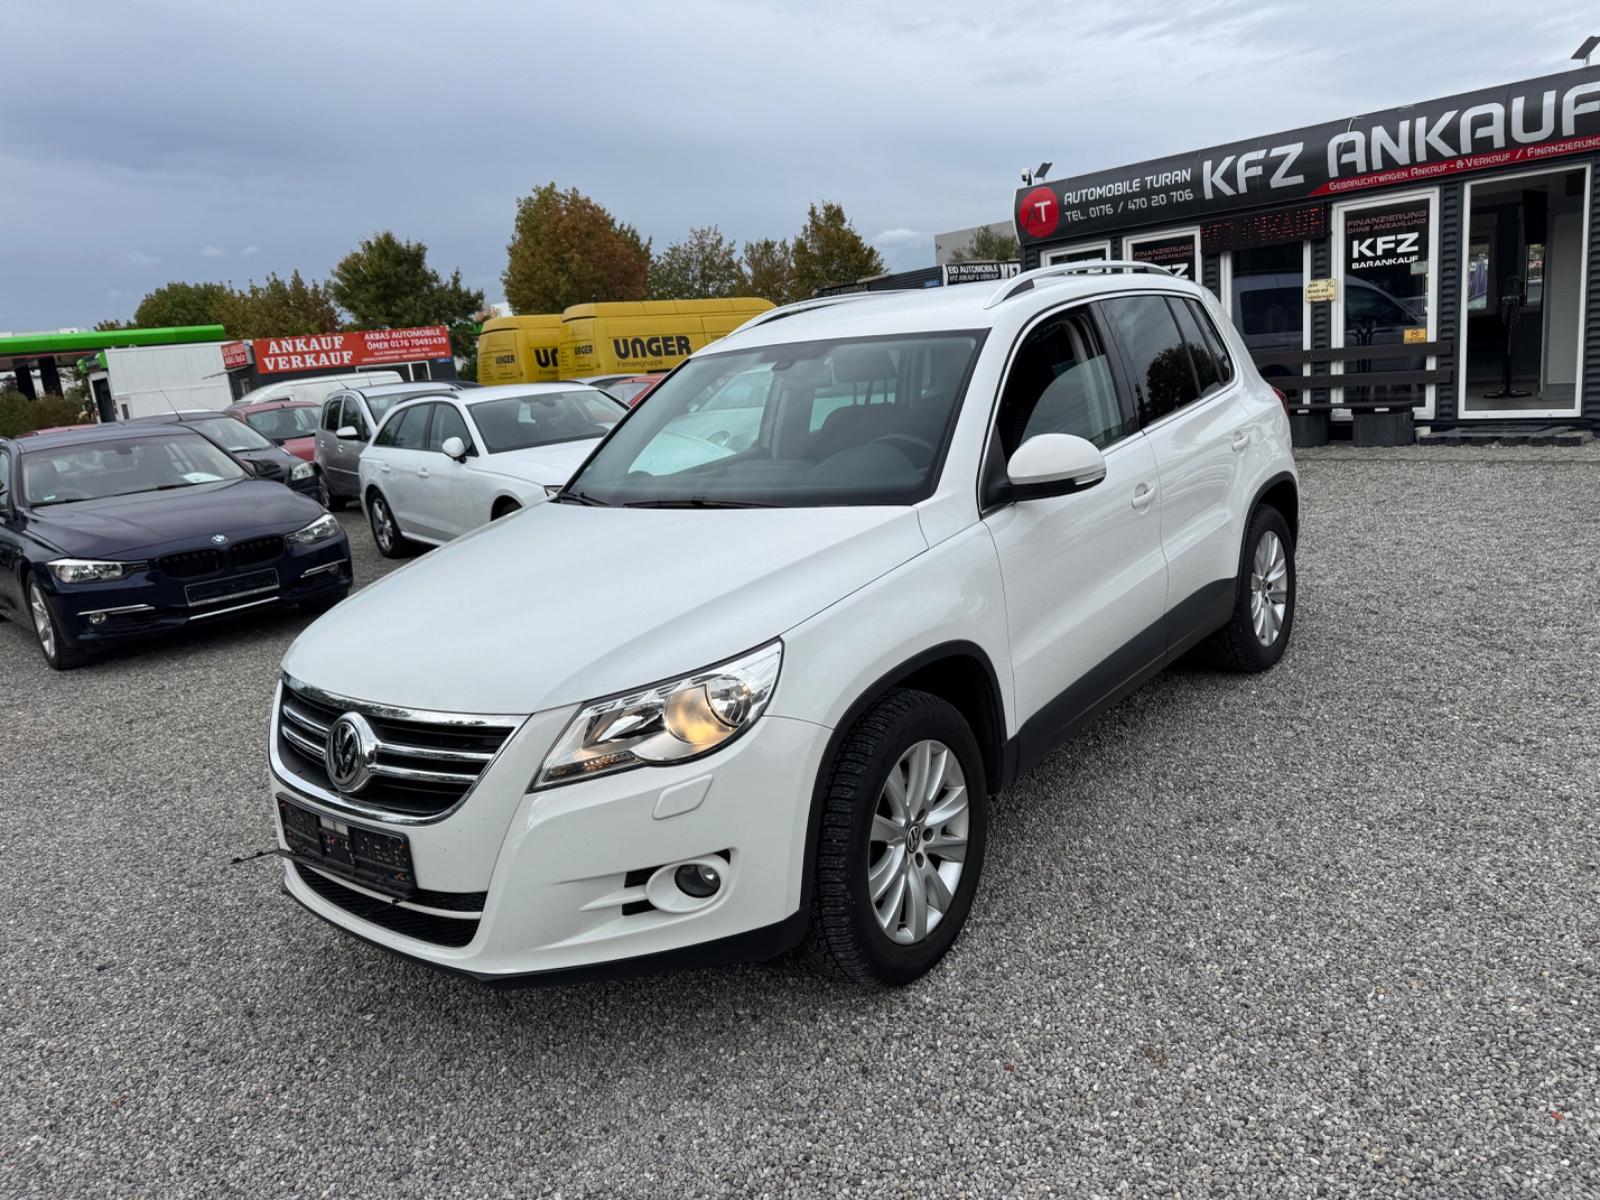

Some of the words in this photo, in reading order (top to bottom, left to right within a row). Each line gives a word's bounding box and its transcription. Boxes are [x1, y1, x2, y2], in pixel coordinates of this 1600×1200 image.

[1202, 141, 1305, 200] KFZ
[1327, 80, 1600, 178] ANKAUF
[1515, 149, 1523, 160] /
[1064, 177, 1141, 206] AUTOMOBILE
[1145, 167, 1192, 190] TURAN
[1065, 209, 1087, 223] TEL.
[1089, 204, 1114, 218] 0176
[1117, 201, 1124, 213] /
[1127, 197, 1148, 211] 470
[1151, 194, 1167, 207] 20
[1170, 188, 1194, 203] 706
[1347, 210, 1427, 228] FINANZIERUNG
[1347, 226, 1371, 234] OHNE
[1373, 218, 1427, 230] ANZAHLUNG
[1352, 232, 1419, 259] KFZ
[1351, 255, 1420, 270] BARANKAUF
[268, 335, 345, 354] ANKAUF
[364, 332, 390, 342] AKBAS
[391, 327, 441, 340] AUTOMOBILE
[613, 334, 693, 360] UNGER
[262, 351, 354, 371] VERKAUF
[616, 359, 664, 369] Firmengruppe
